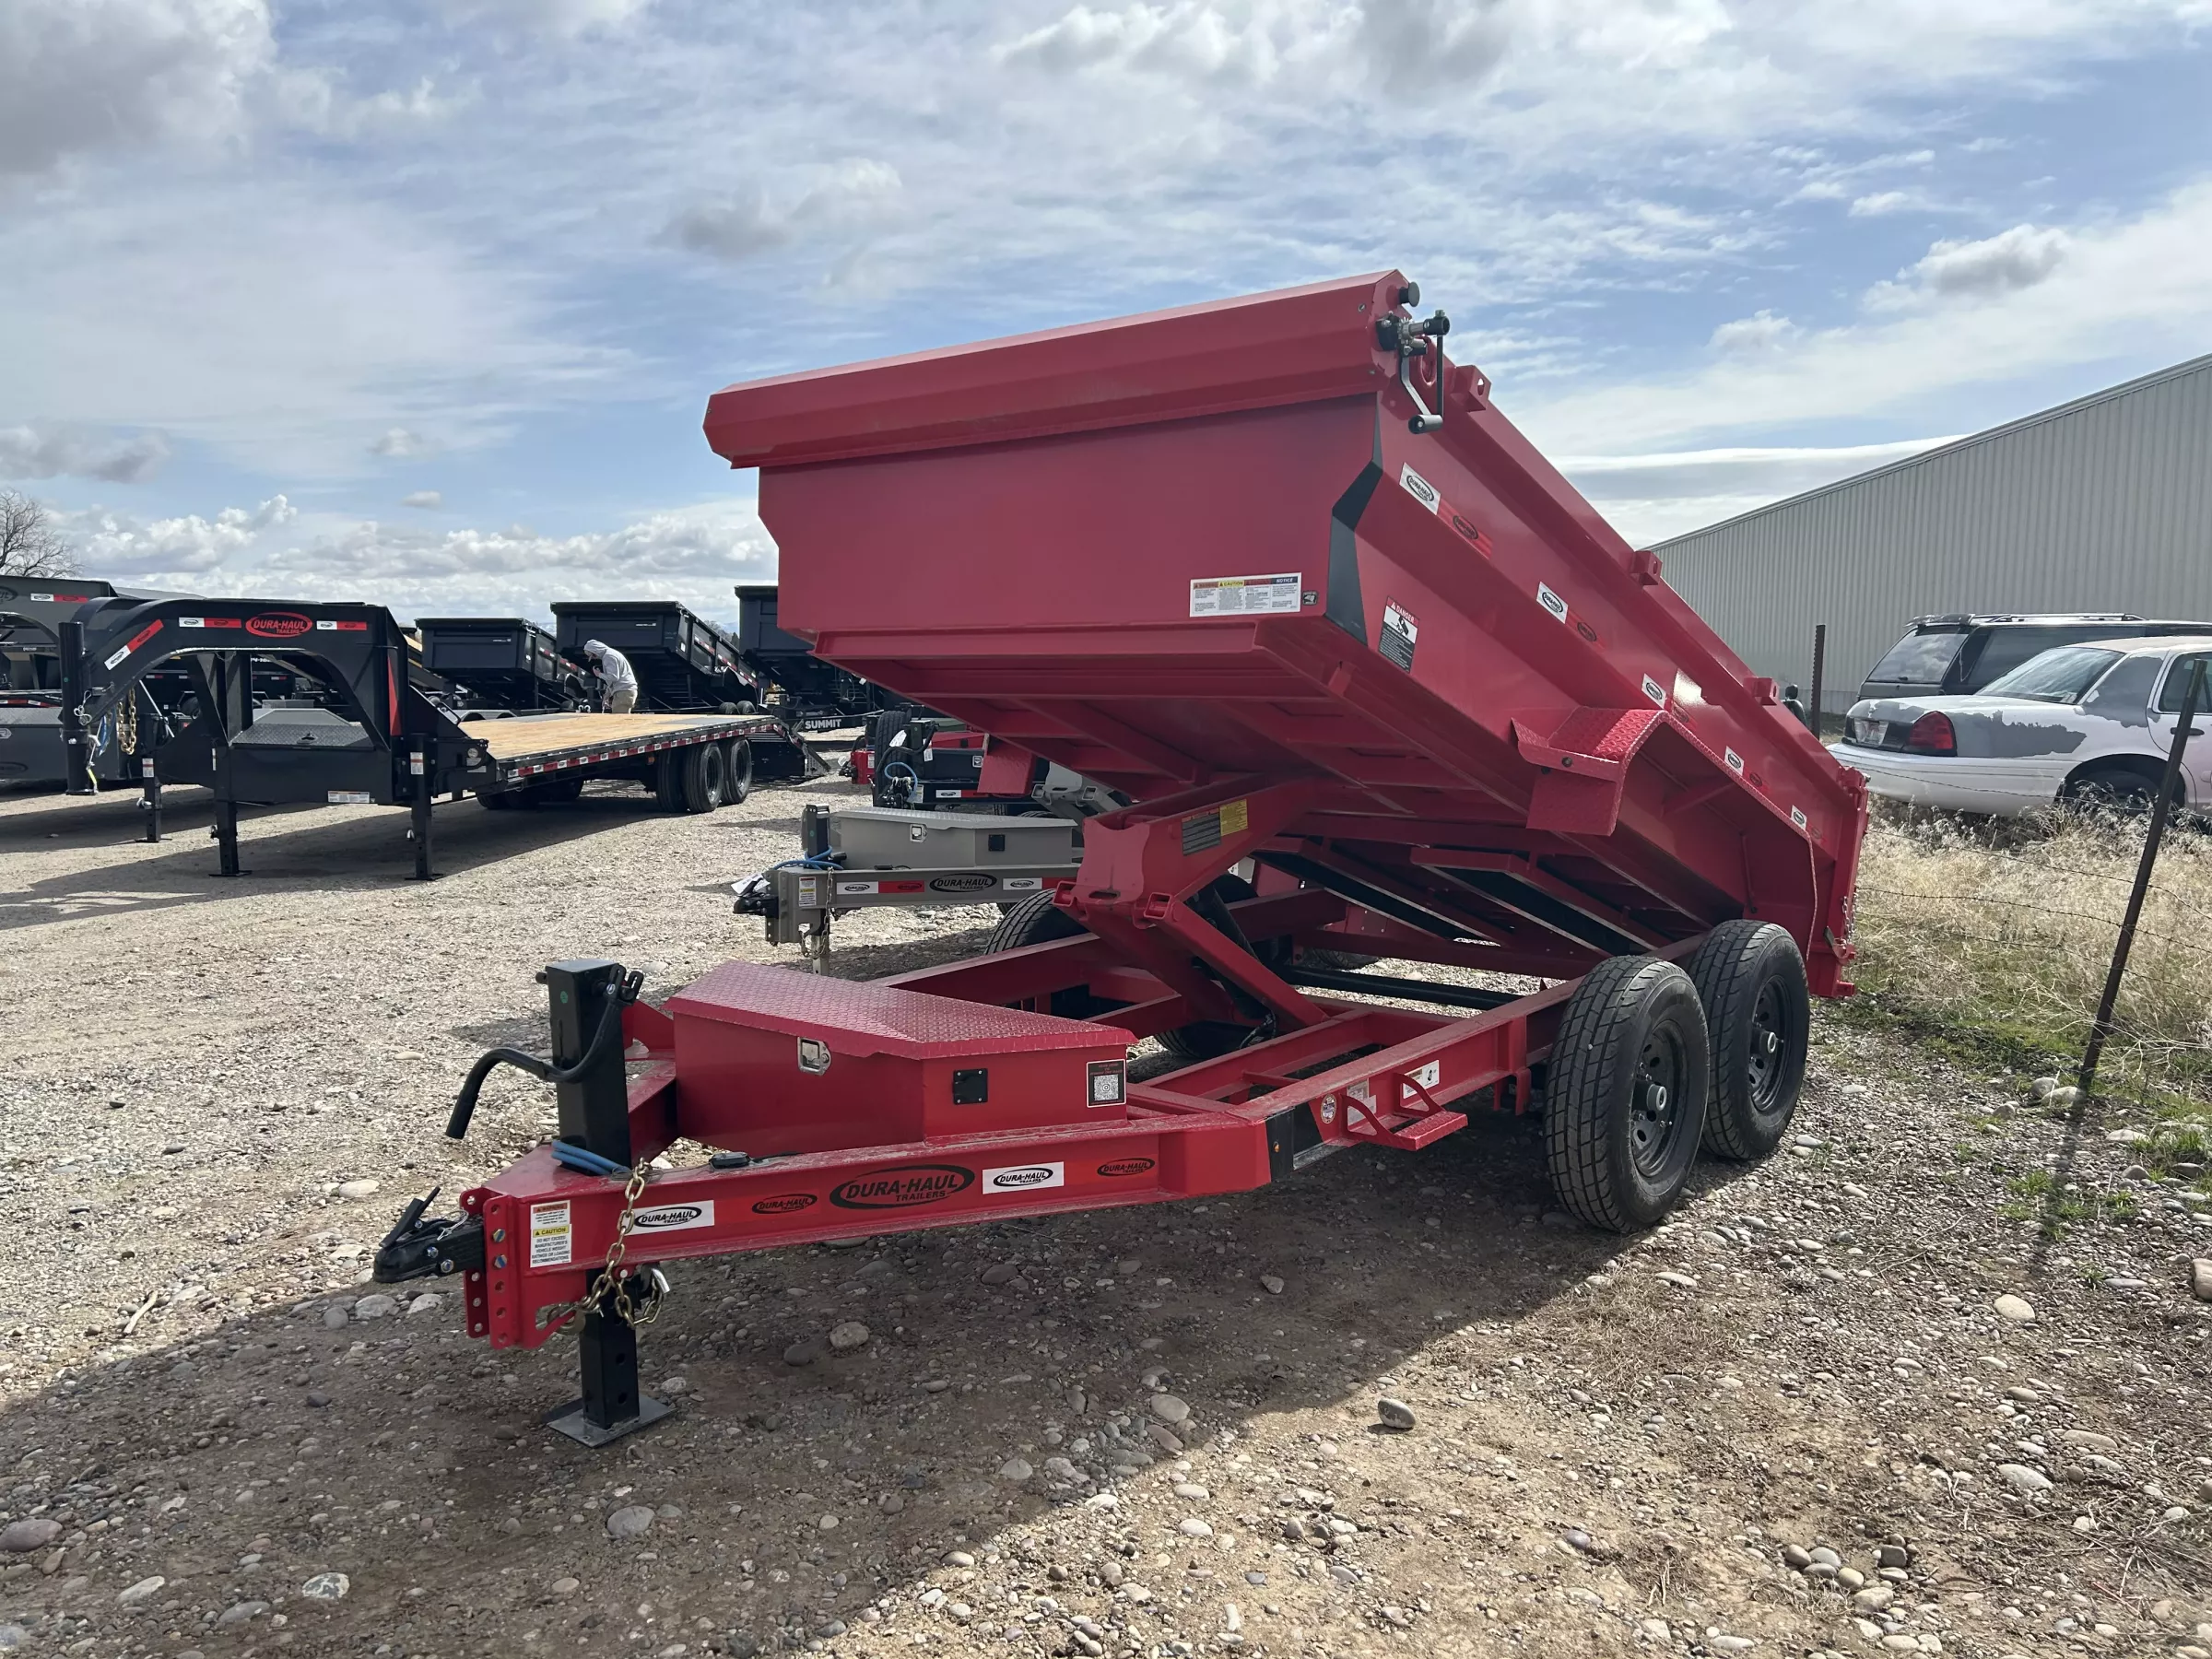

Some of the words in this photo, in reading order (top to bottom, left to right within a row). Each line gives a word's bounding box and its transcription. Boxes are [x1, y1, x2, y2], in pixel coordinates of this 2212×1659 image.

[1396, 605, 1415, 624] DANGER
[253, 618, 305, 629] DURA-HAUL
[805, 719, 841, 729] SUMMIT
[937, 878, 990, 887] DURA-HAUL
[1102, 1161, 1148, 1172] DURA-HAUL
[1000, 1171, 1046, 1182] DURA-HAUL
[846, 1174, 958, 1199] DURA-HAUL
[896, 1190, 946, 1202] TRAILERS
[759, 1198, 810, 1210] DURA-HAUL
[641, 1210, 694, 1223] DURA-HAUL
[541, 1227, 566, 1235] CAUTION
